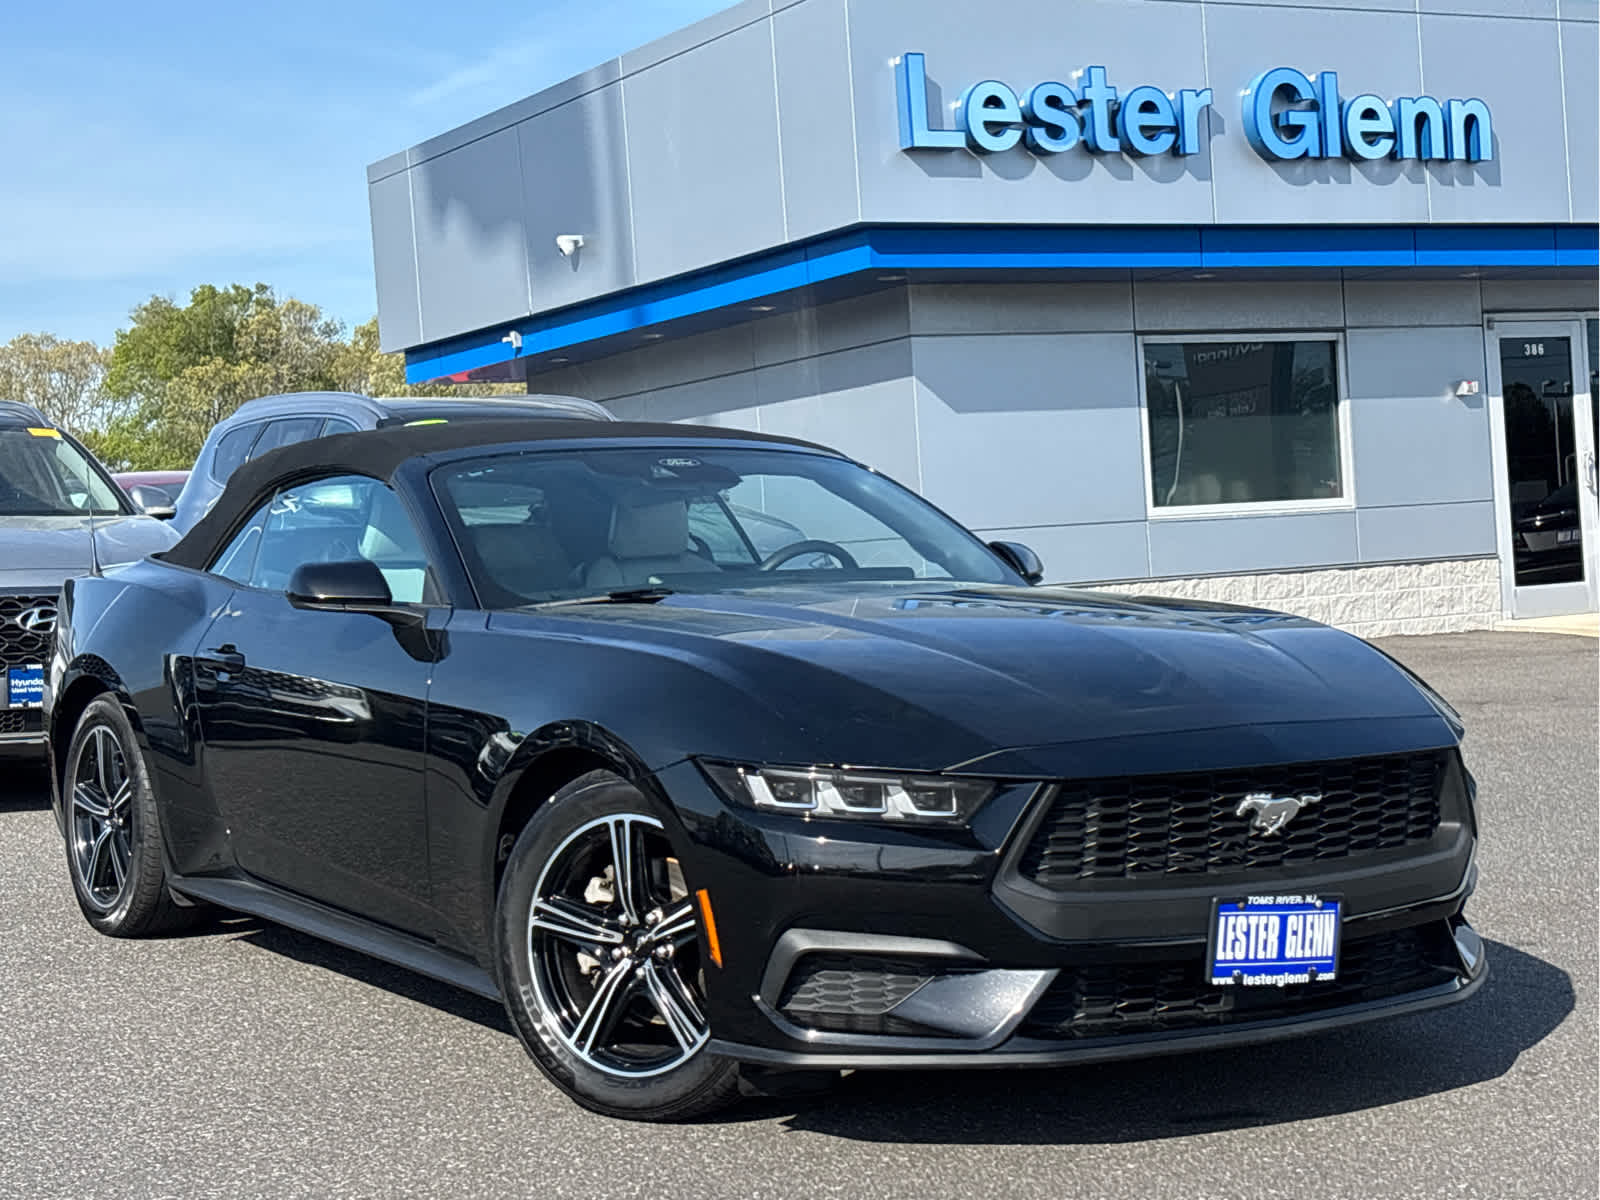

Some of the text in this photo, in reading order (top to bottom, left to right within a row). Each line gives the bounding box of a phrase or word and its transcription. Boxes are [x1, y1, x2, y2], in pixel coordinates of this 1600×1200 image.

[898, 53, 1494, 162] Lester Glenn
[1524, 343, 1544, 356] 386
[11, 678, 44, 687] Hyunda
[1247, 895, 1275, 905] TOMS
[1304, 893, 1318, 904] NJ
[1216, 914, 1335, 960] LESTER GLENN
